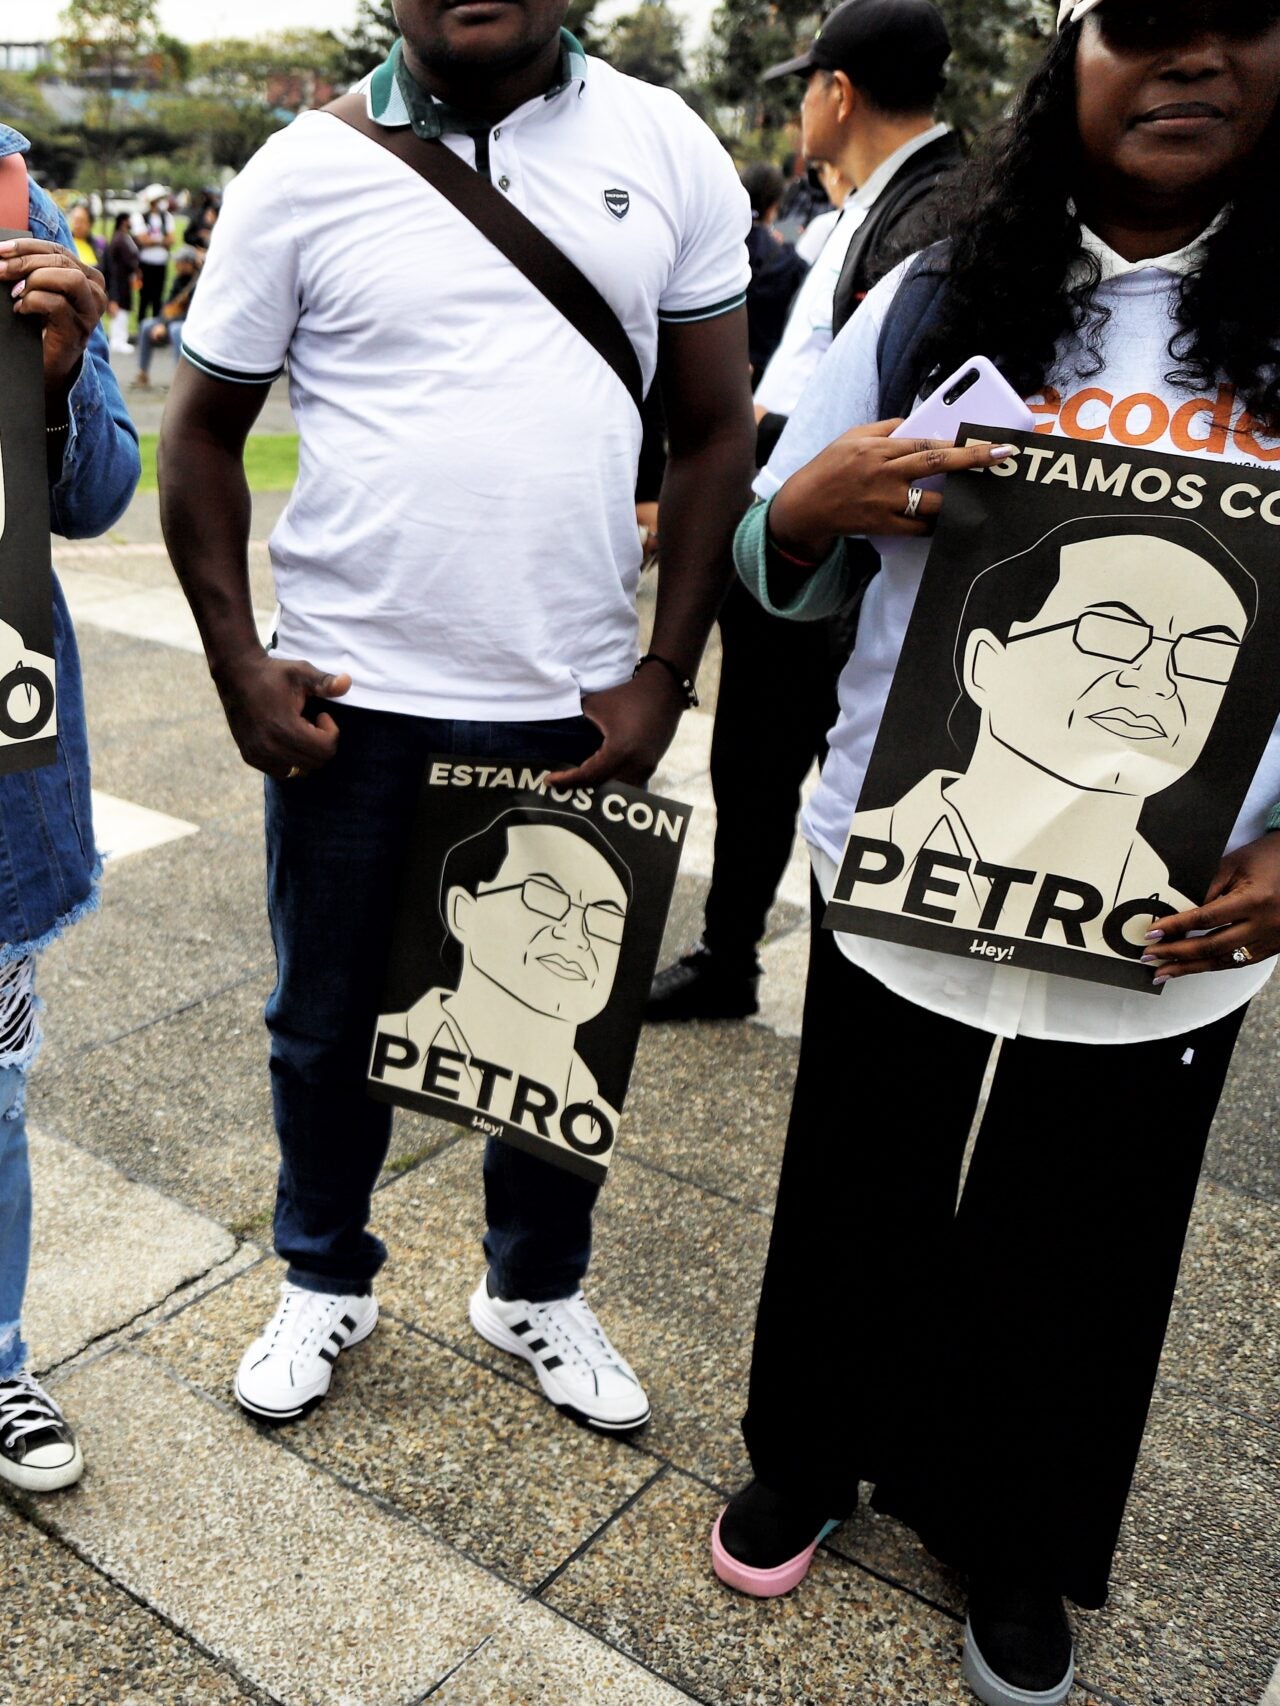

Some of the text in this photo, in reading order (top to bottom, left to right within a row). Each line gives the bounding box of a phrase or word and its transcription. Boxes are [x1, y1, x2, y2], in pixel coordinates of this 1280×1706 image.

[601, 793, 685, 843] CON
[832, 834, 1186, 962] PETRO
[969, 939, 1015, 962] Hey!
[370, 1031, 615, 1157] PETRO
[471, 1114, 504, 1137] Hey!
